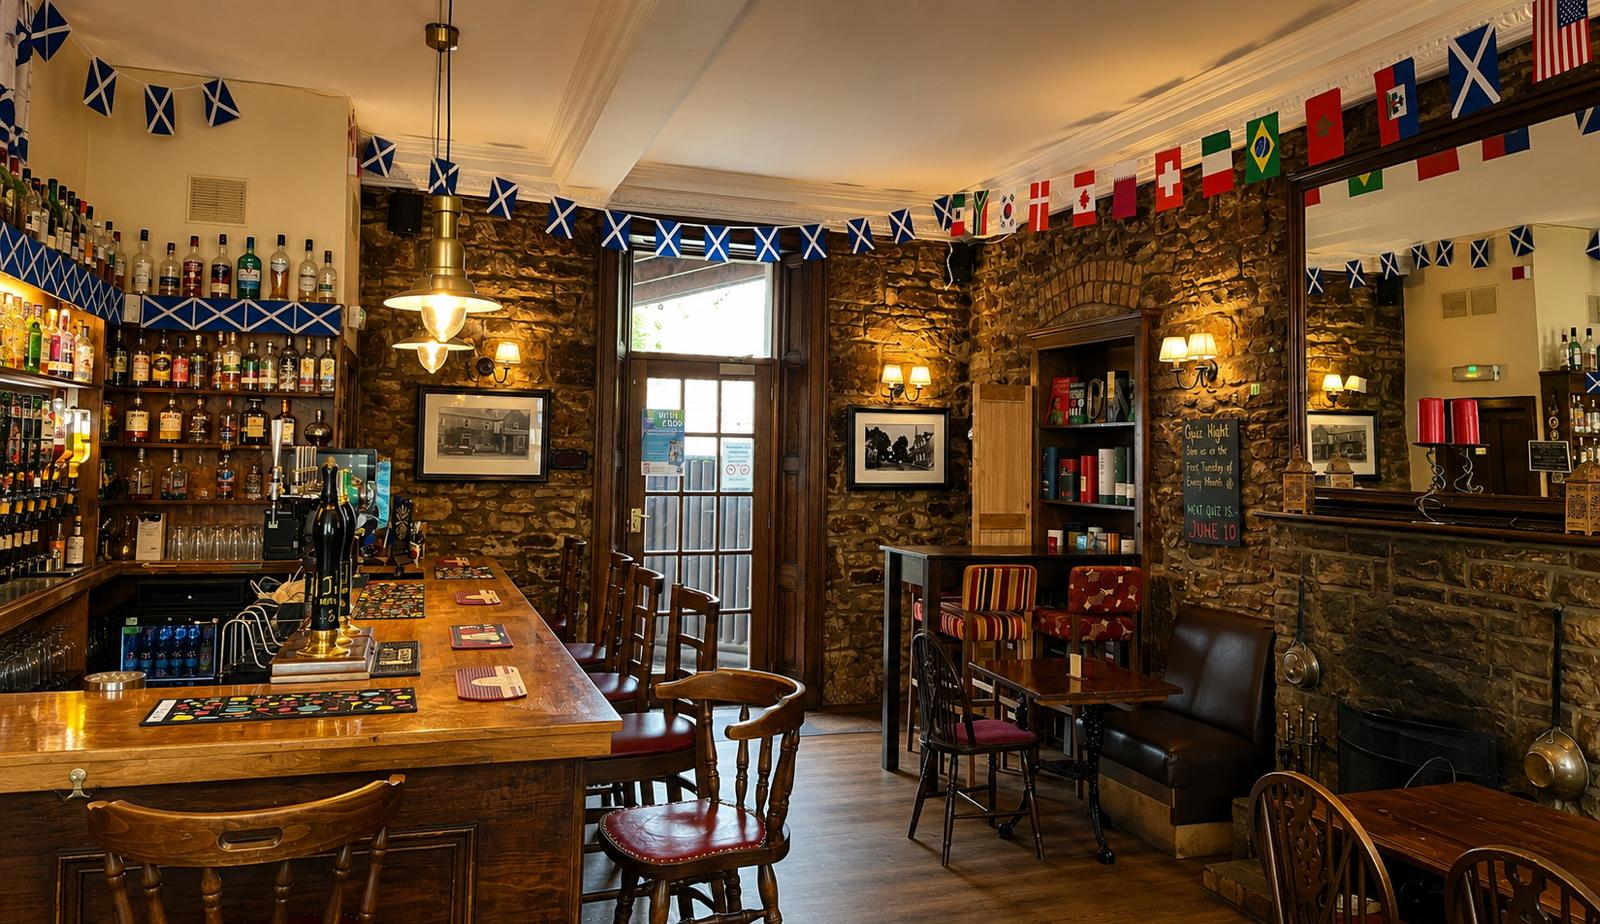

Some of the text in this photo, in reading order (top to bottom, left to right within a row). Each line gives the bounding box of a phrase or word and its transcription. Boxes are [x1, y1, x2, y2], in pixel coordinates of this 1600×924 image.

[1208, 424, 1229, 444] Night
[1217, 445, 1228, 456] the
[1201, 460, 1224, 475] Tuesday
[1226, 460, 1233, 475] of
[1204, 476, 1223, 487] Month
[1187, 504, 1202, 516] NEXT
[1206, 505, 1221, 518] QUIZ
[1189, 520, 1237, 541] JUNE 10
